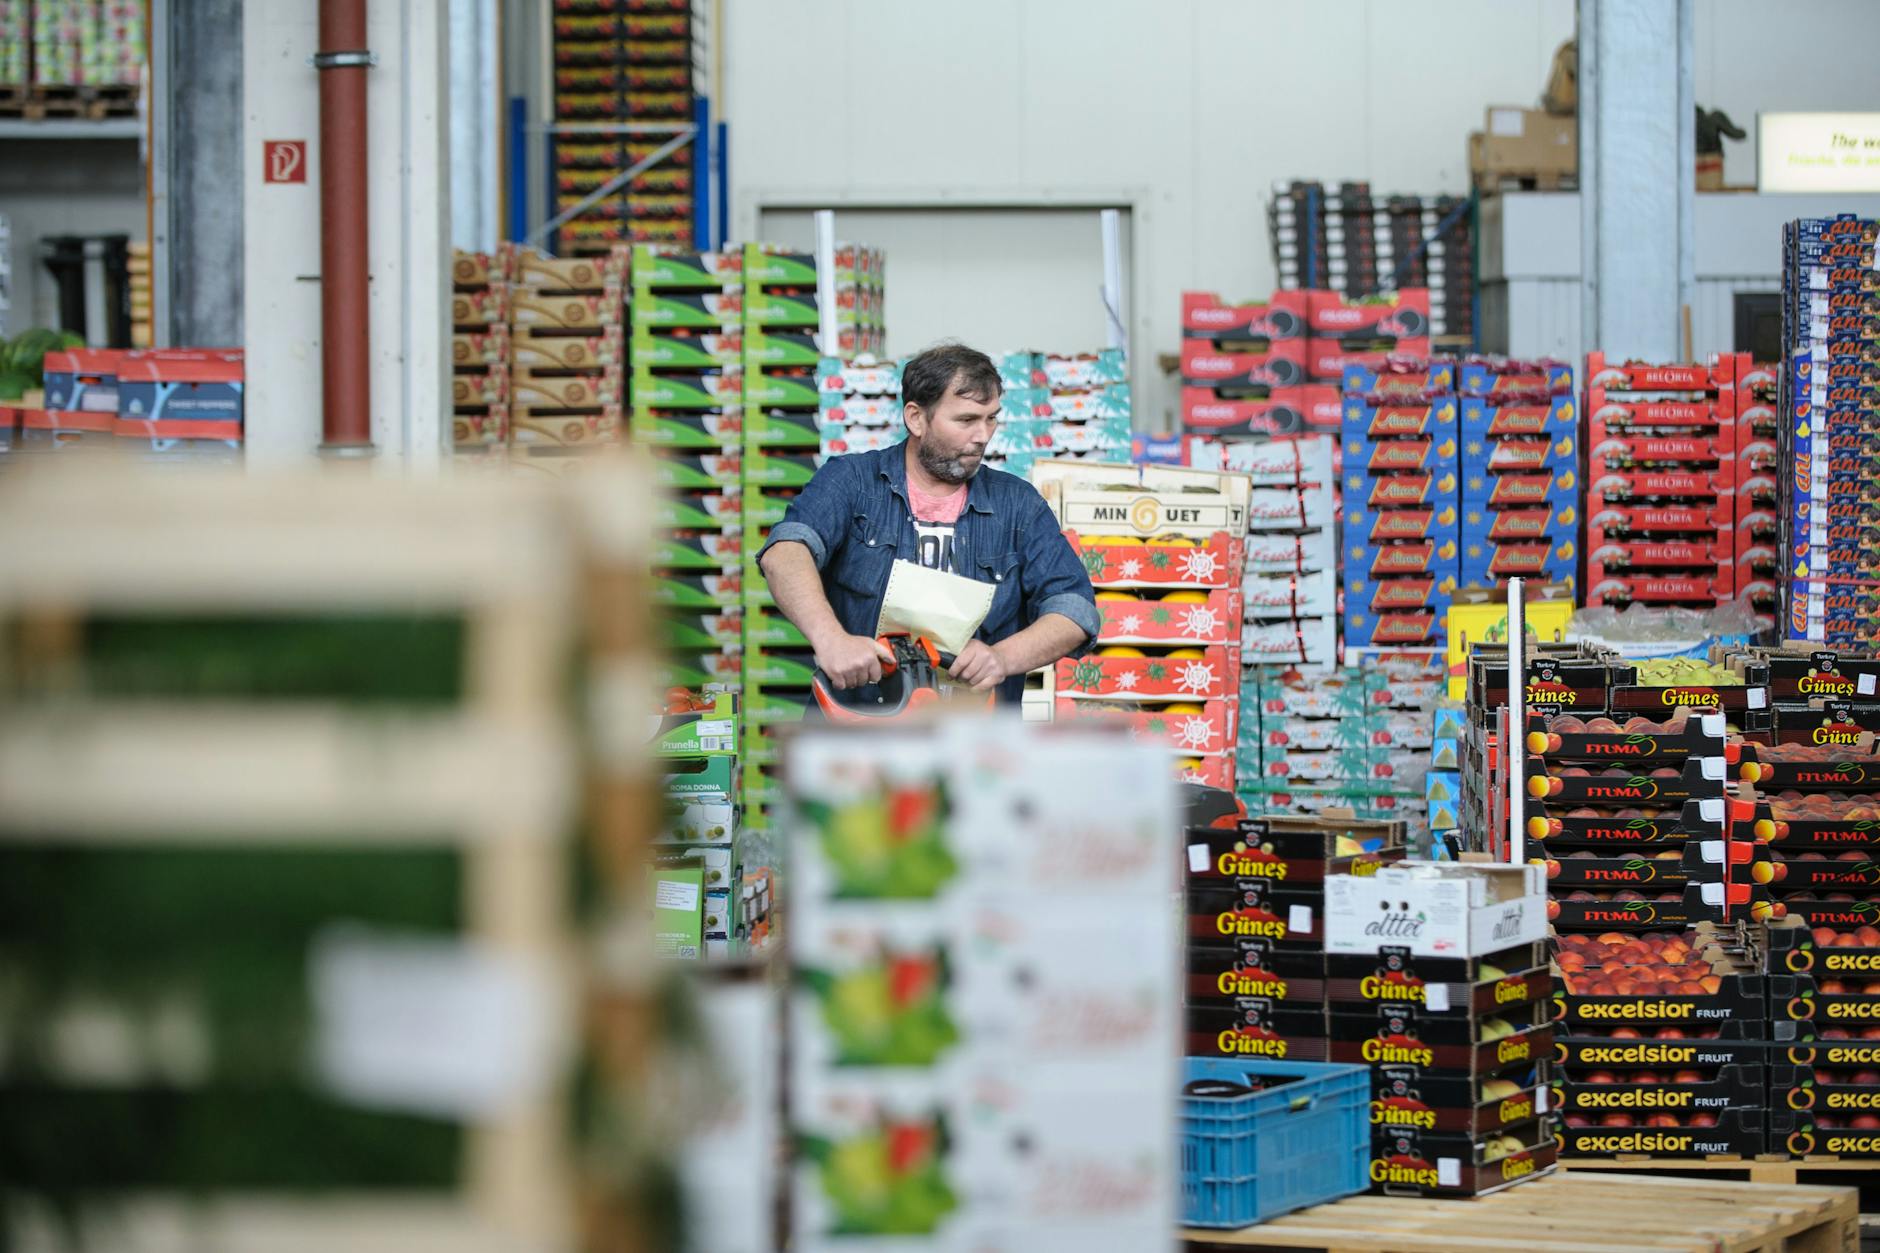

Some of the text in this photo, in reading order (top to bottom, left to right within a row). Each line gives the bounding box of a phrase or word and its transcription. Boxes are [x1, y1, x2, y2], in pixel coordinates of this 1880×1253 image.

[1093, 507, 1201, 522] MIN UET
[1536, 661, 1556, 670] Turkey
[1816, 653, 1836, 661] Turkey
[1798, 676, 1855, 696] Güneş
[1661, 688, 1720, 706] Güneş
[1536, 705, 1557, 714] Turkey
[1831, 703, 1851, 711] Turkey
[662, 739, 699, 749] Prunella
[1812, 727, 1860, 745] Güne
[1240, 822, 1265, 832] Turkey
[1217, 852, 1288, 880] Güneş
[1216, 912, 1287, 940] Güneş
[1217, 971, 1288, 999] Güneş
[1578, 1000, 1732, 1019] excelsior FRUIT
[1217, 1030, 1288, 1058] Güneş
[1362, 1039, 1434, 1067] Güneş
[1580, 1044, 1733, 1063] excelsior FRUIT
[1576, 1089, 1730, 1107] excelsior FRUIT
[1368, 1101, 1437, 1129] Güneş
[1576, 1133, 1729, 1152] excelsior FRUIT
[1370, 1159, 1438, 1187] Güneş
